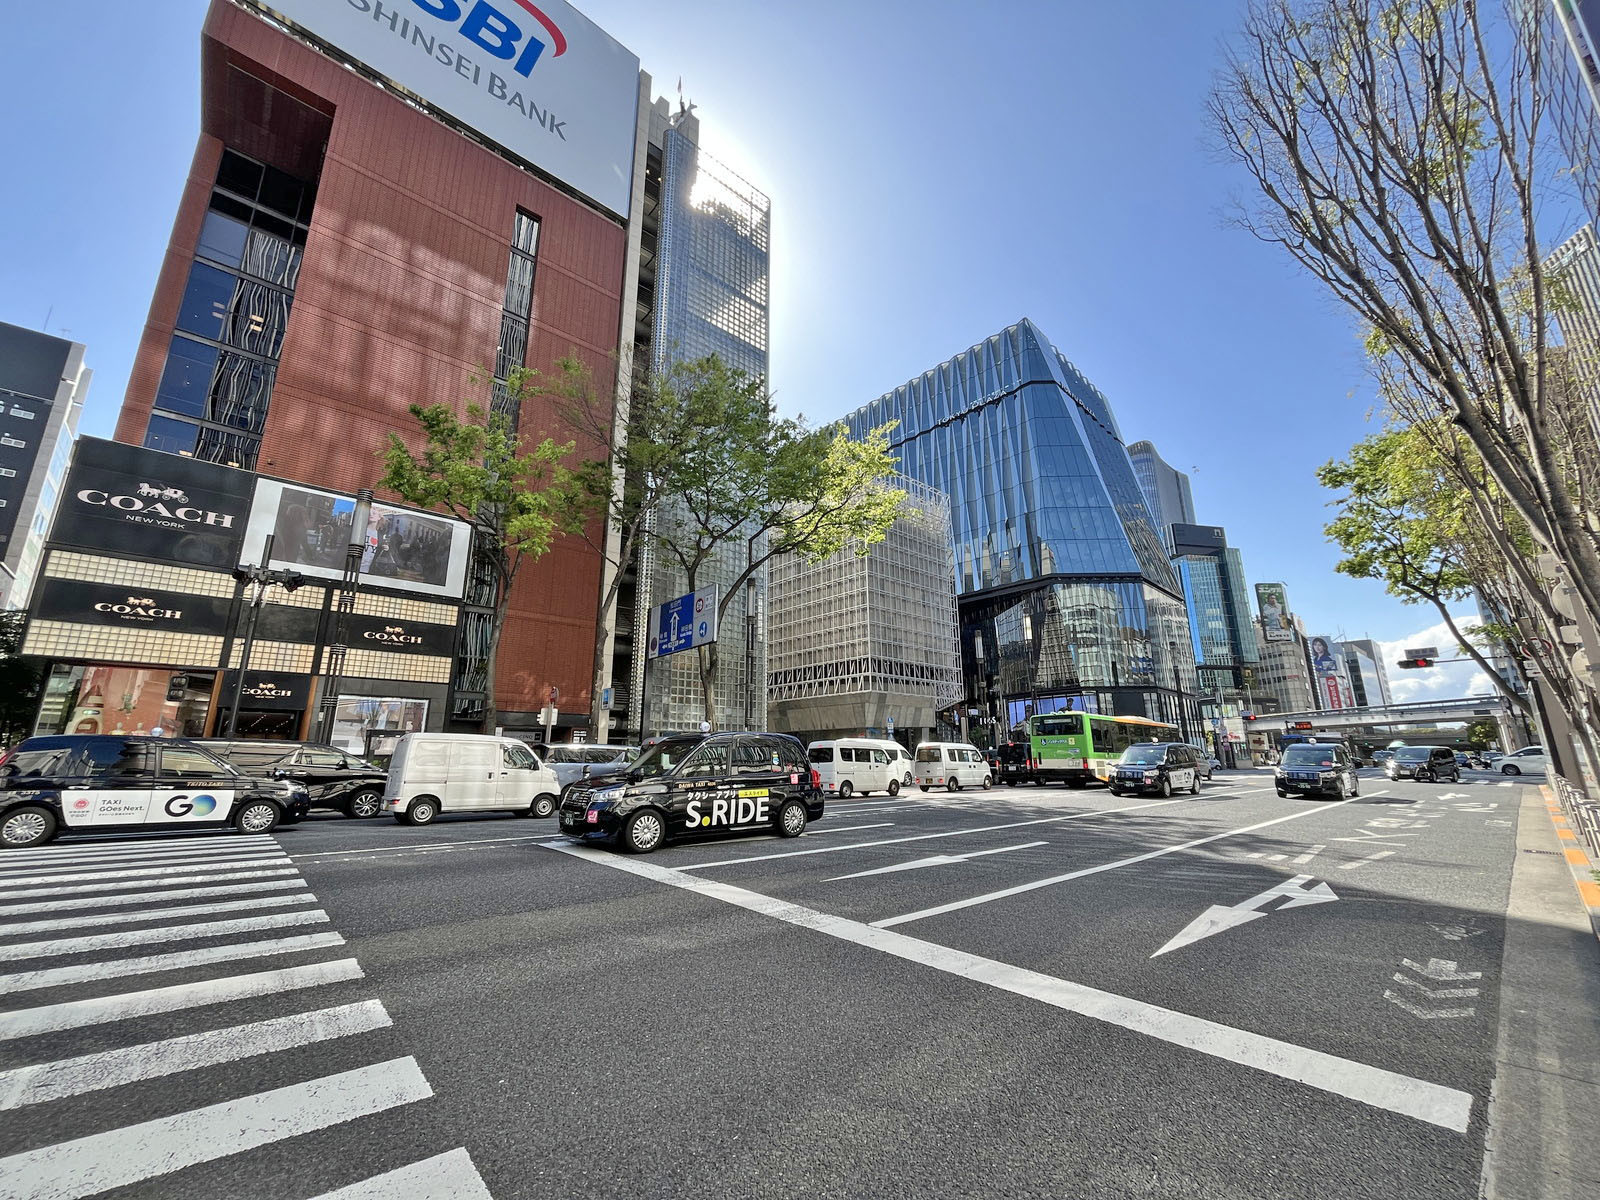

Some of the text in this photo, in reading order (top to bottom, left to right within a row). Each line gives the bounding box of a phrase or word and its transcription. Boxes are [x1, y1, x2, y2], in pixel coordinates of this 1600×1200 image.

[487, 71, 567, 141] BANK
[77, 489, 235, 529] COACH
[125, 514, 186, 530] NEW YORK
[94, 602, 183, 620] COACH
[363, 631, 423, 644] COACH
[241, 687, 292, 697] COACH
[687, 790, 736, 801] タクシーアプリ
[164, 794, 217, 817] GO
